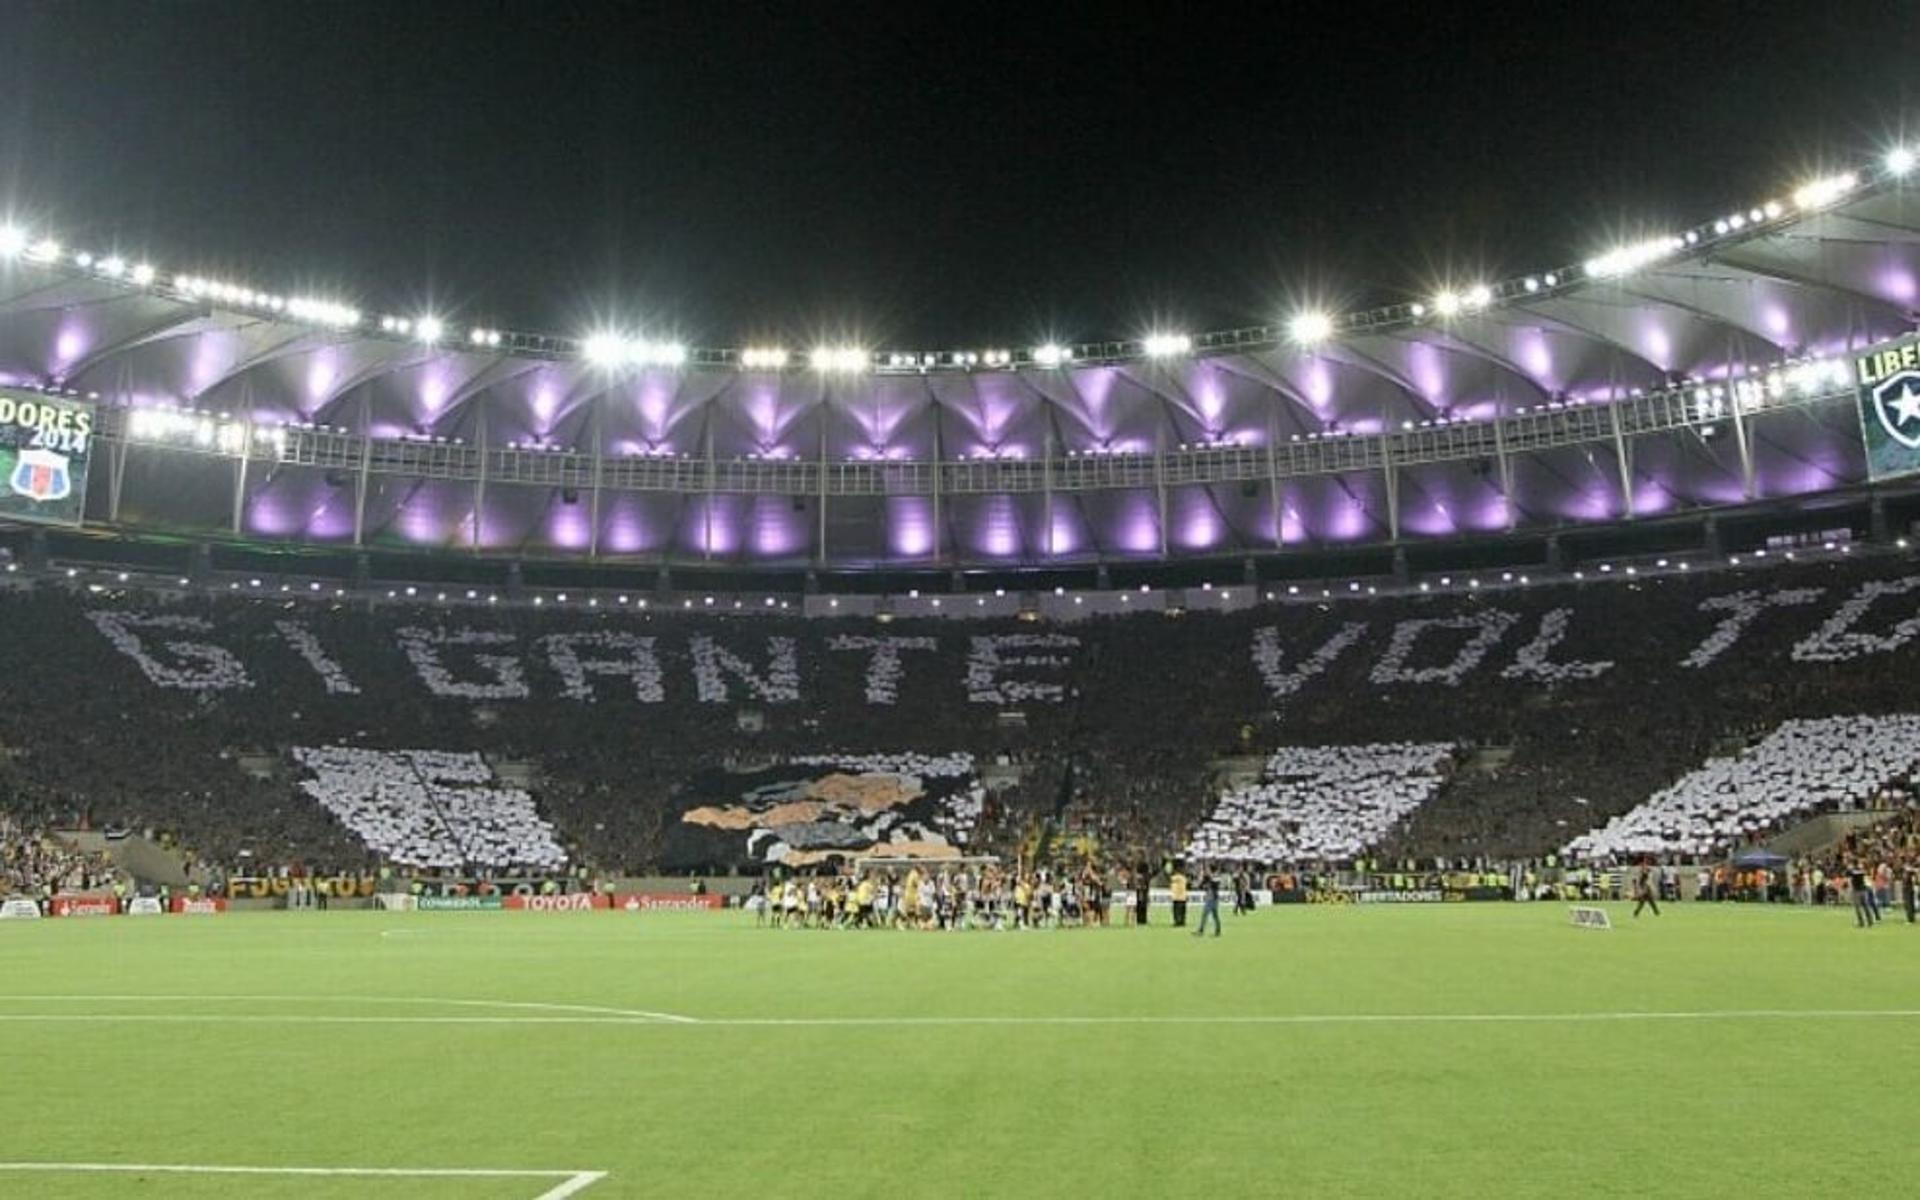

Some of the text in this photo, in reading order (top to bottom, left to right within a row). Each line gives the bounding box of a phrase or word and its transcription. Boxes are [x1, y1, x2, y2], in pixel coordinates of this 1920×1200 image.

[1857, 341, 1920, 384] LIBE
[30, 426, 87, 453] 2014
[85, 609, 1081, 705] GIGANTE
[522, 894, 592, 911] TOYOTA
[641, 896, 711, 911] Santander
